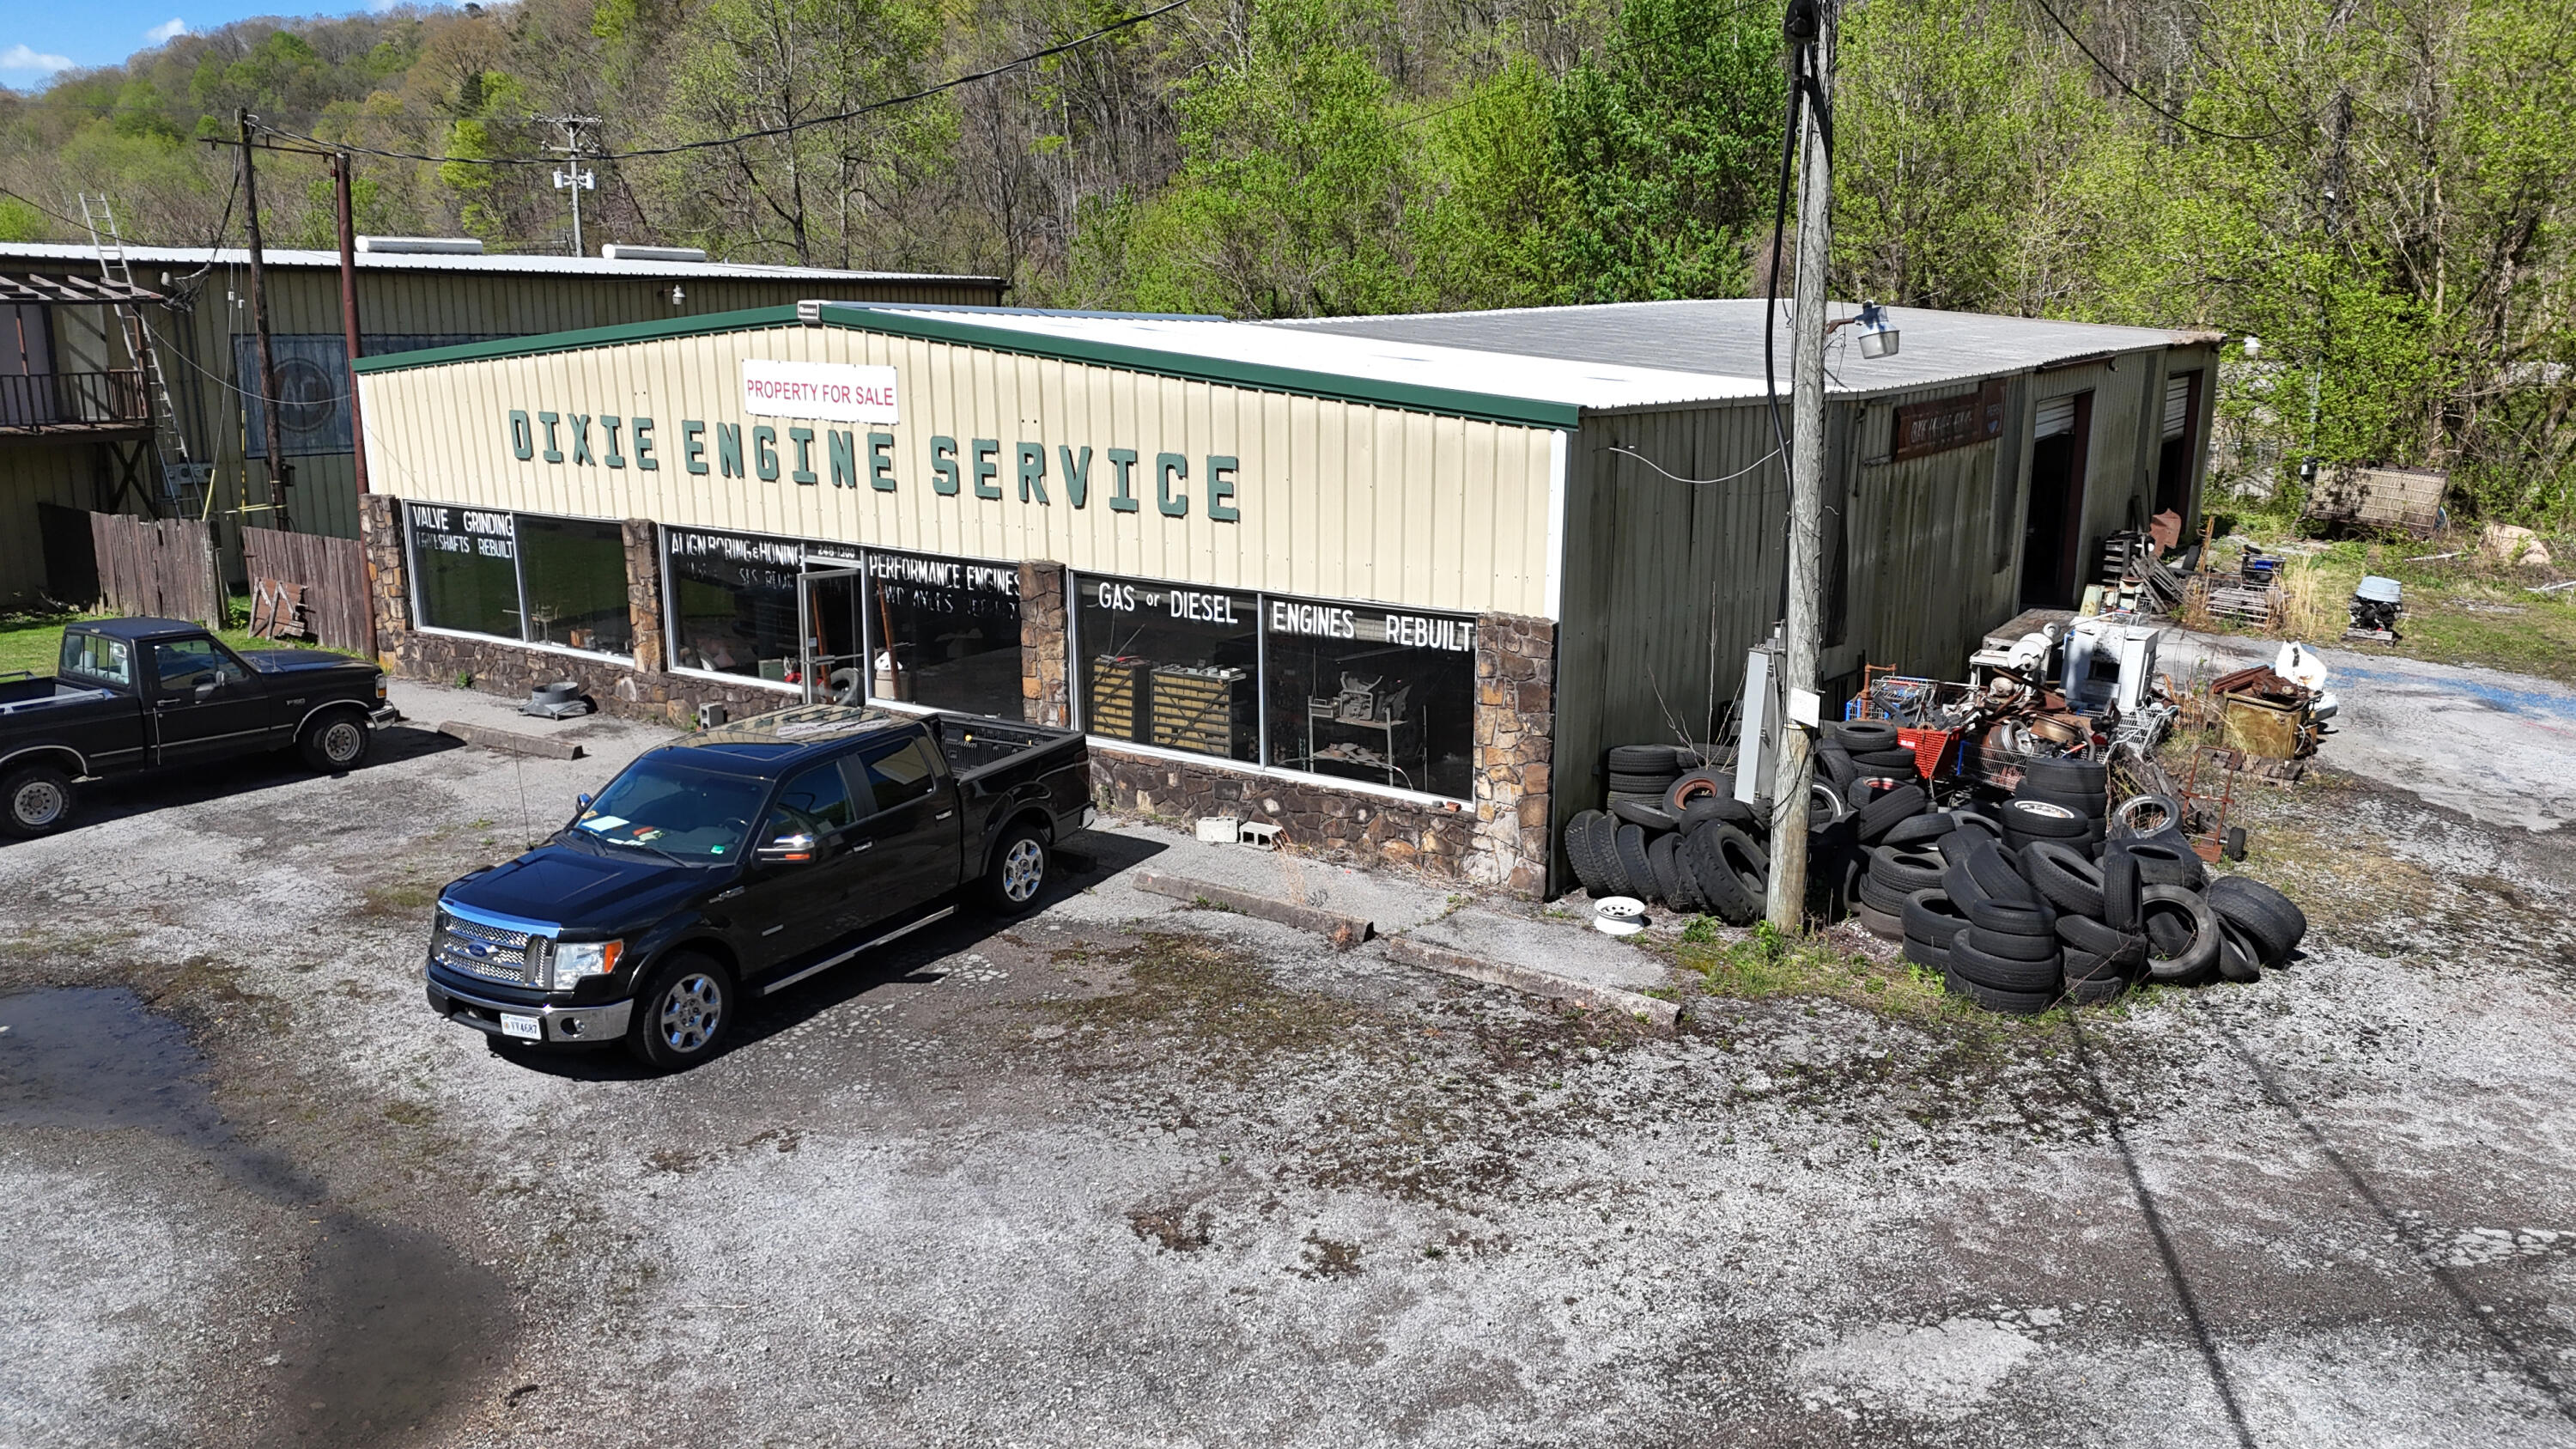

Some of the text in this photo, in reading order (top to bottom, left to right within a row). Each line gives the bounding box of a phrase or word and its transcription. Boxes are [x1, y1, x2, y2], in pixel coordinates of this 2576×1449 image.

[746, 379, 894, 406] PROPERTY FOR SALE
[508, 409, 1240, 522] DIXIE ENGINE SERVICE
[412, 505, 513, 537] VALVE GRINDING
[477, 537, 513, 558] REBUILT
[671, 533, 706, 556] ALIGN
[869, 553, 1019, 597] PERFORMANCE ENGINES
[1098, 581, 1238, 624] GAS or DIESEL
[1273, 600, 1473, 652] ENGINES REBUILT
